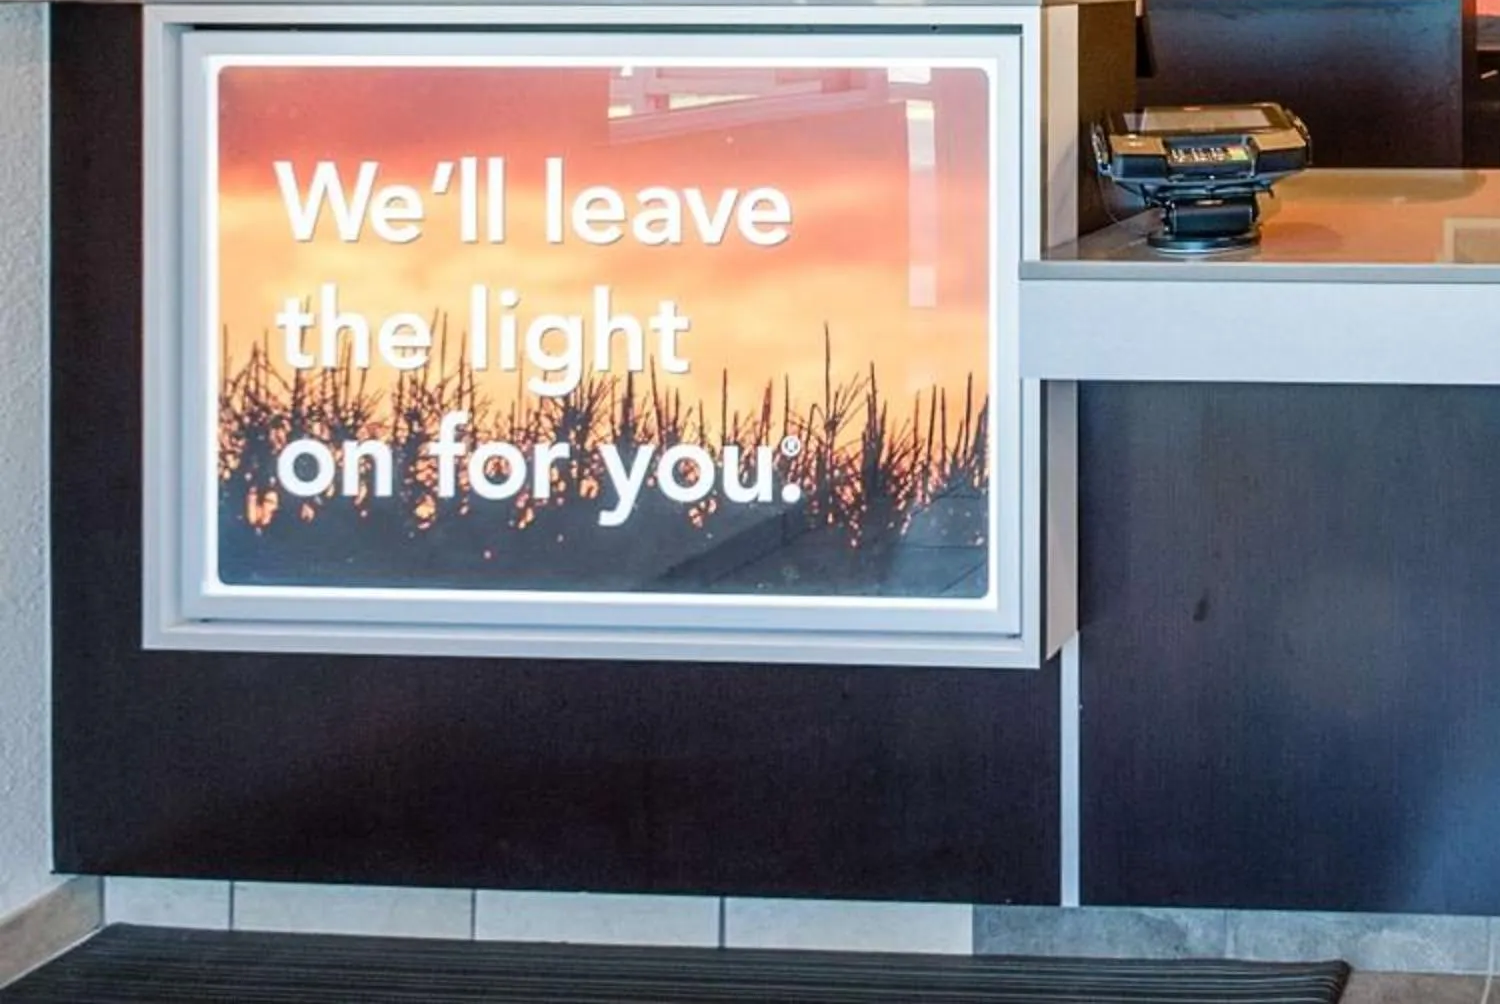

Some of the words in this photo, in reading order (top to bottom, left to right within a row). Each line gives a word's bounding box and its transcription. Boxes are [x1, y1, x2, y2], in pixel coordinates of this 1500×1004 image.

[273, 156, 504, 244] We'll
[545, 156, 793, 245] leave
[275, 282, 434, 372] the
[470, 283, 691, 396] light
[277, 437, 393, 497] on
[429, 411, 571, 499] for
